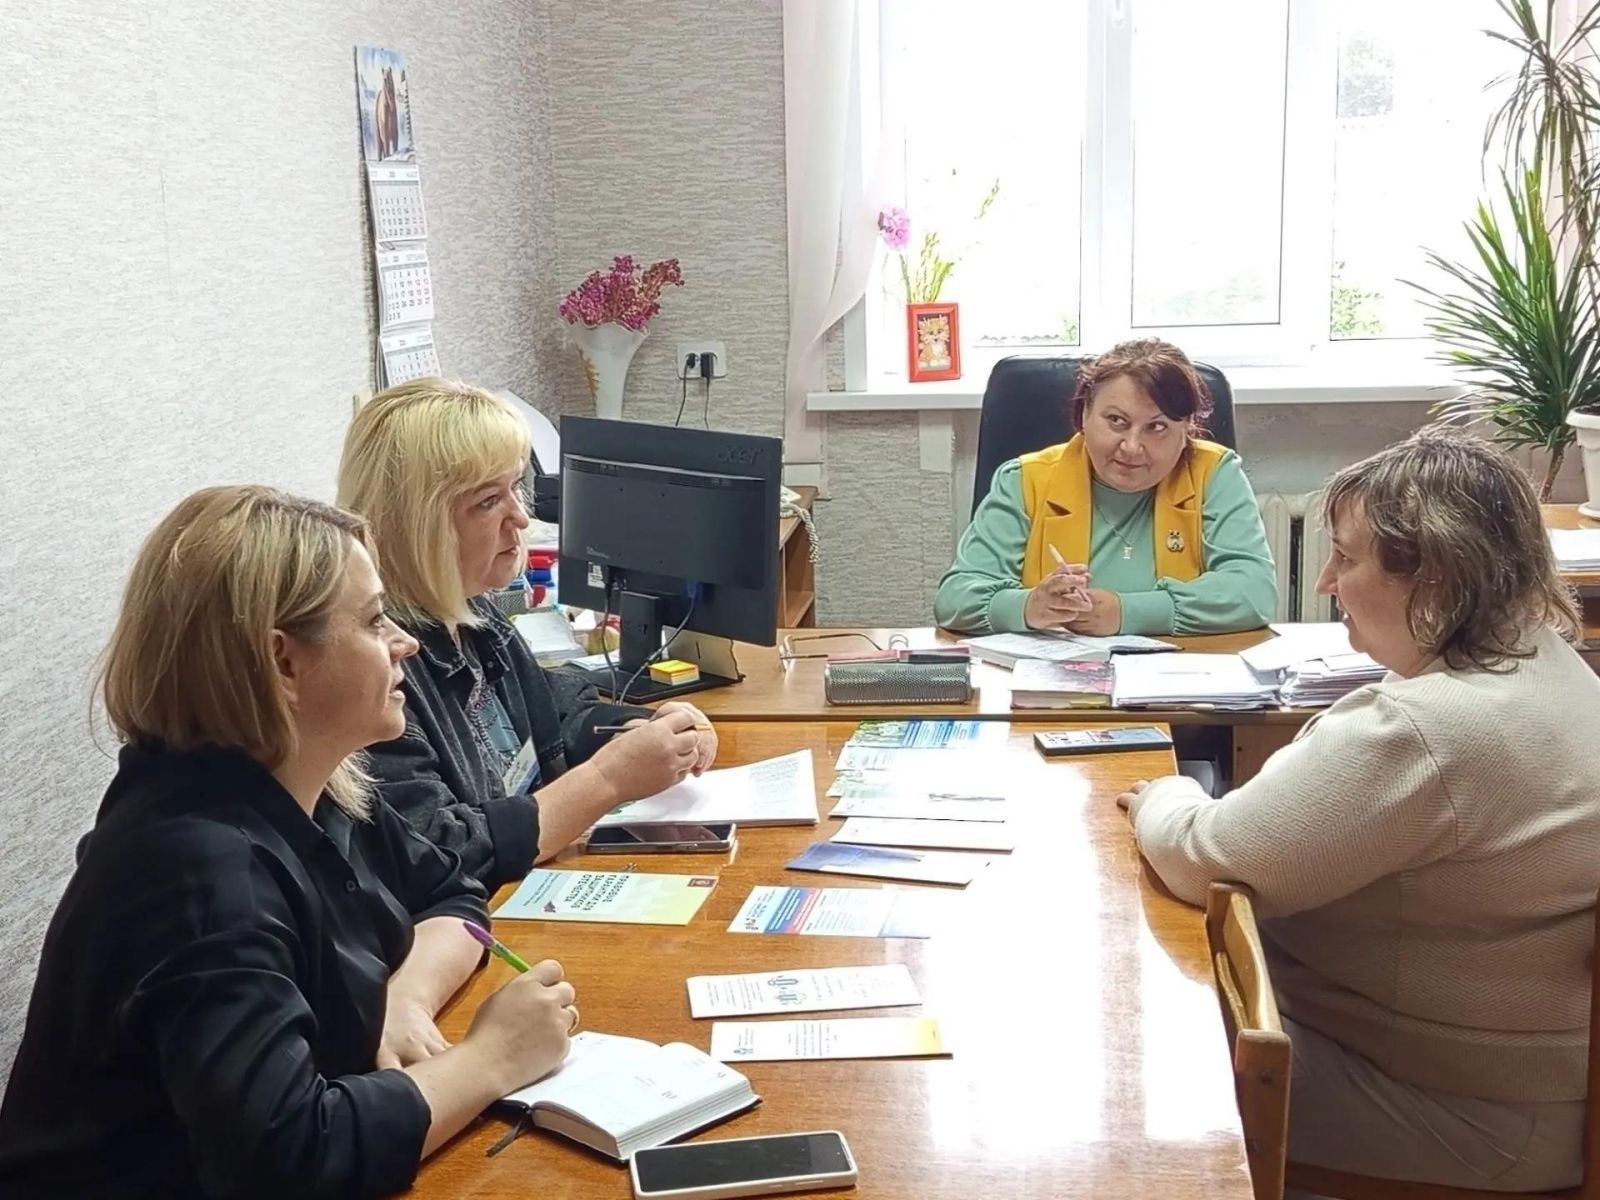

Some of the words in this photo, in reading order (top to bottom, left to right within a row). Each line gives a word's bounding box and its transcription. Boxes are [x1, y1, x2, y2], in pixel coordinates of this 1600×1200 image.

[715, 446, 758, 466] acer
[563, 874, 592, 902] ОТЕЧЕСТВА
[602, 874, 629, 902] ПРАВОВЫЕ
